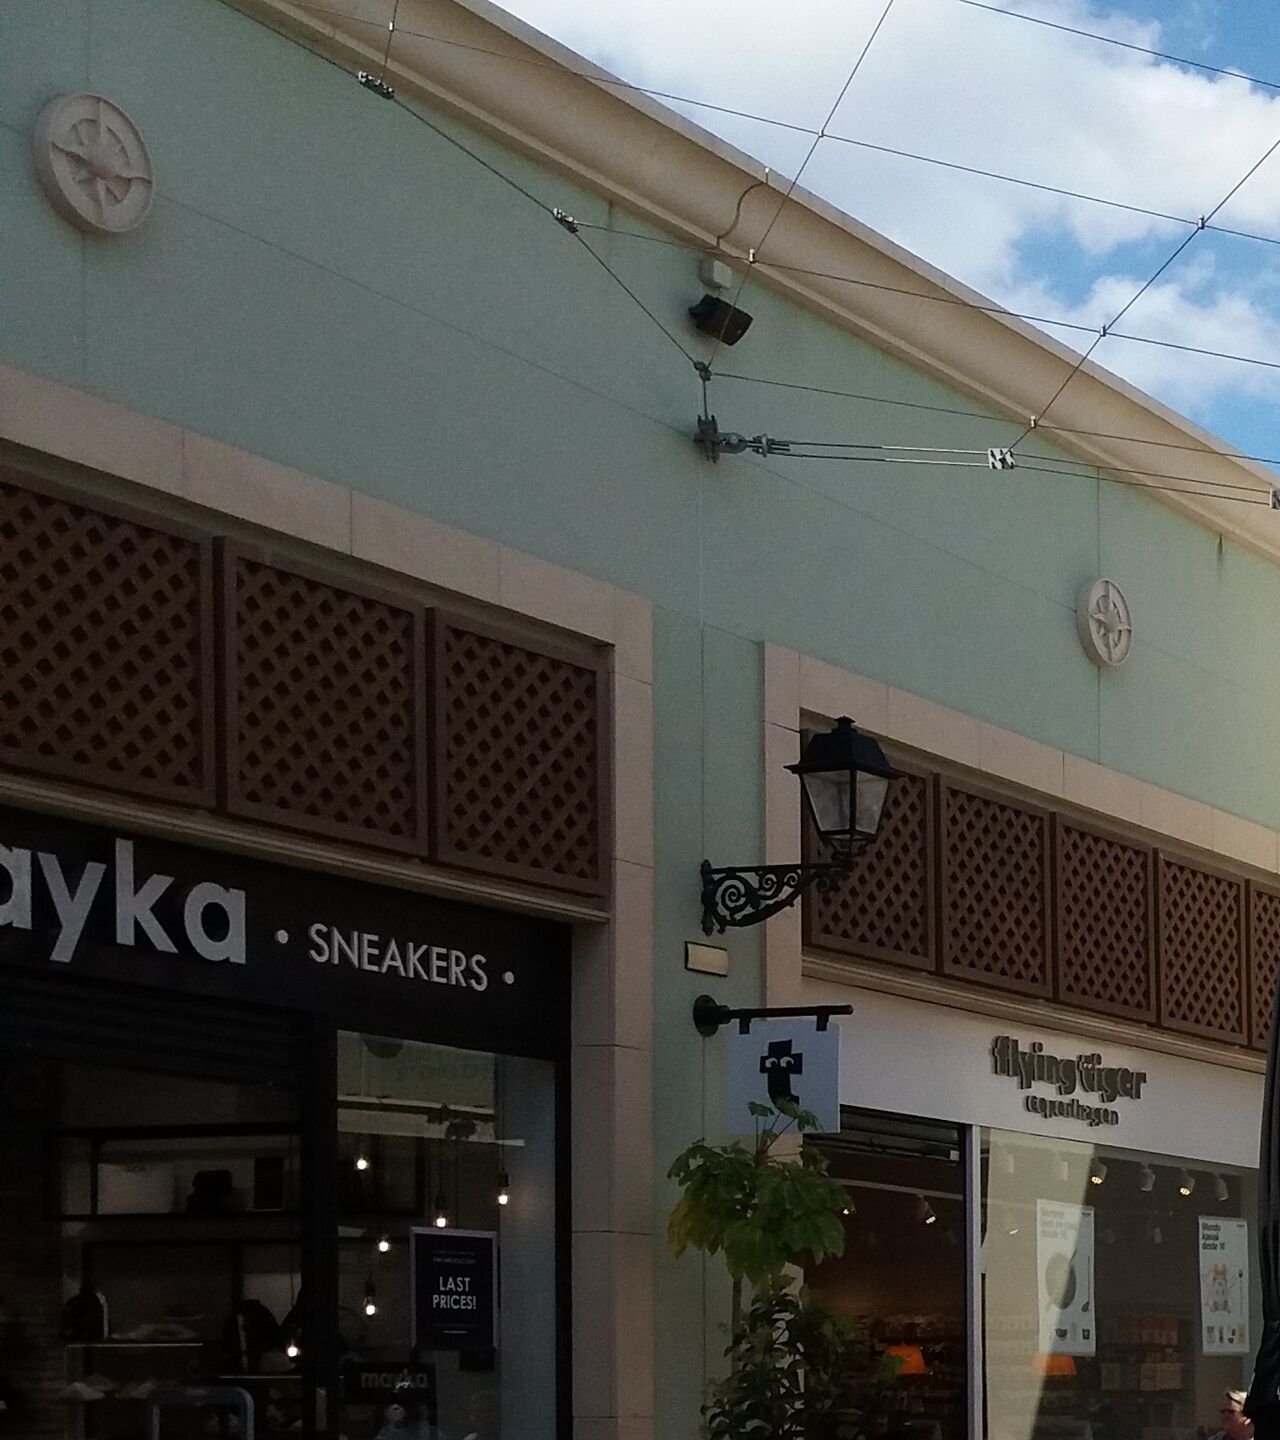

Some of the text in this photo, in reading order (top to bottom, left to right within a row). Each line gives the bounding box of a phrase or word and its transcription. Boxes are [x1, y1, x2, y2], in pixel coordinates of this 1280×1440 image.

[307, 922, 489, 992] SNEAKERS
[990, 1035, 1148, 1104] flying tiger
[1024, 1095, 1120, 1127] copenhagen
[439, 1276, 471, 1292] LAST
[432, 1294, 477, 1310] PRICES!
